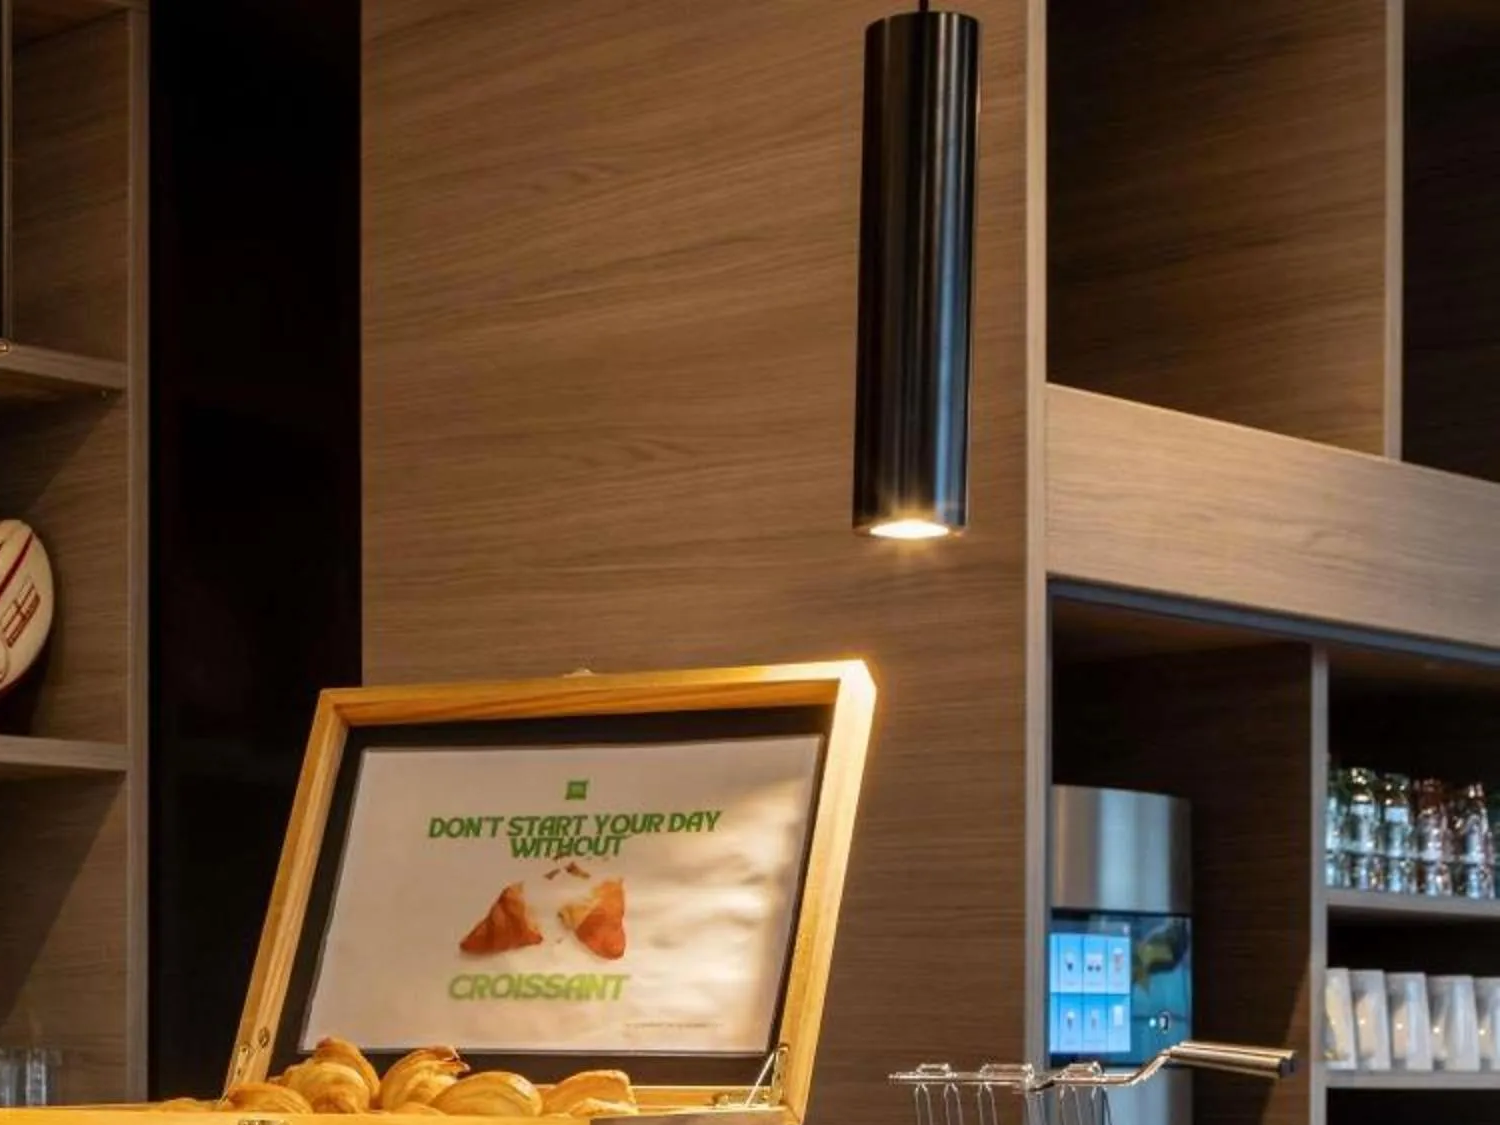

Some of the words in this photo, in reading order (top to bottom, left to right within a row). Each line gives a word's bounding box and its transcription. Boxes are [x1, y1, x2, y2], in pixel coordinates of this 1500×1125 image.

[428, 816, 504, 839] DON'T
[506, 815, 588, 837] START
[593, 813, 665, 834] YOUR
[667, 811, 721, 833] DAY
[510, 836, 626, 857] WITHOUT
[449, 974, 629, 1000] CROISSANT
